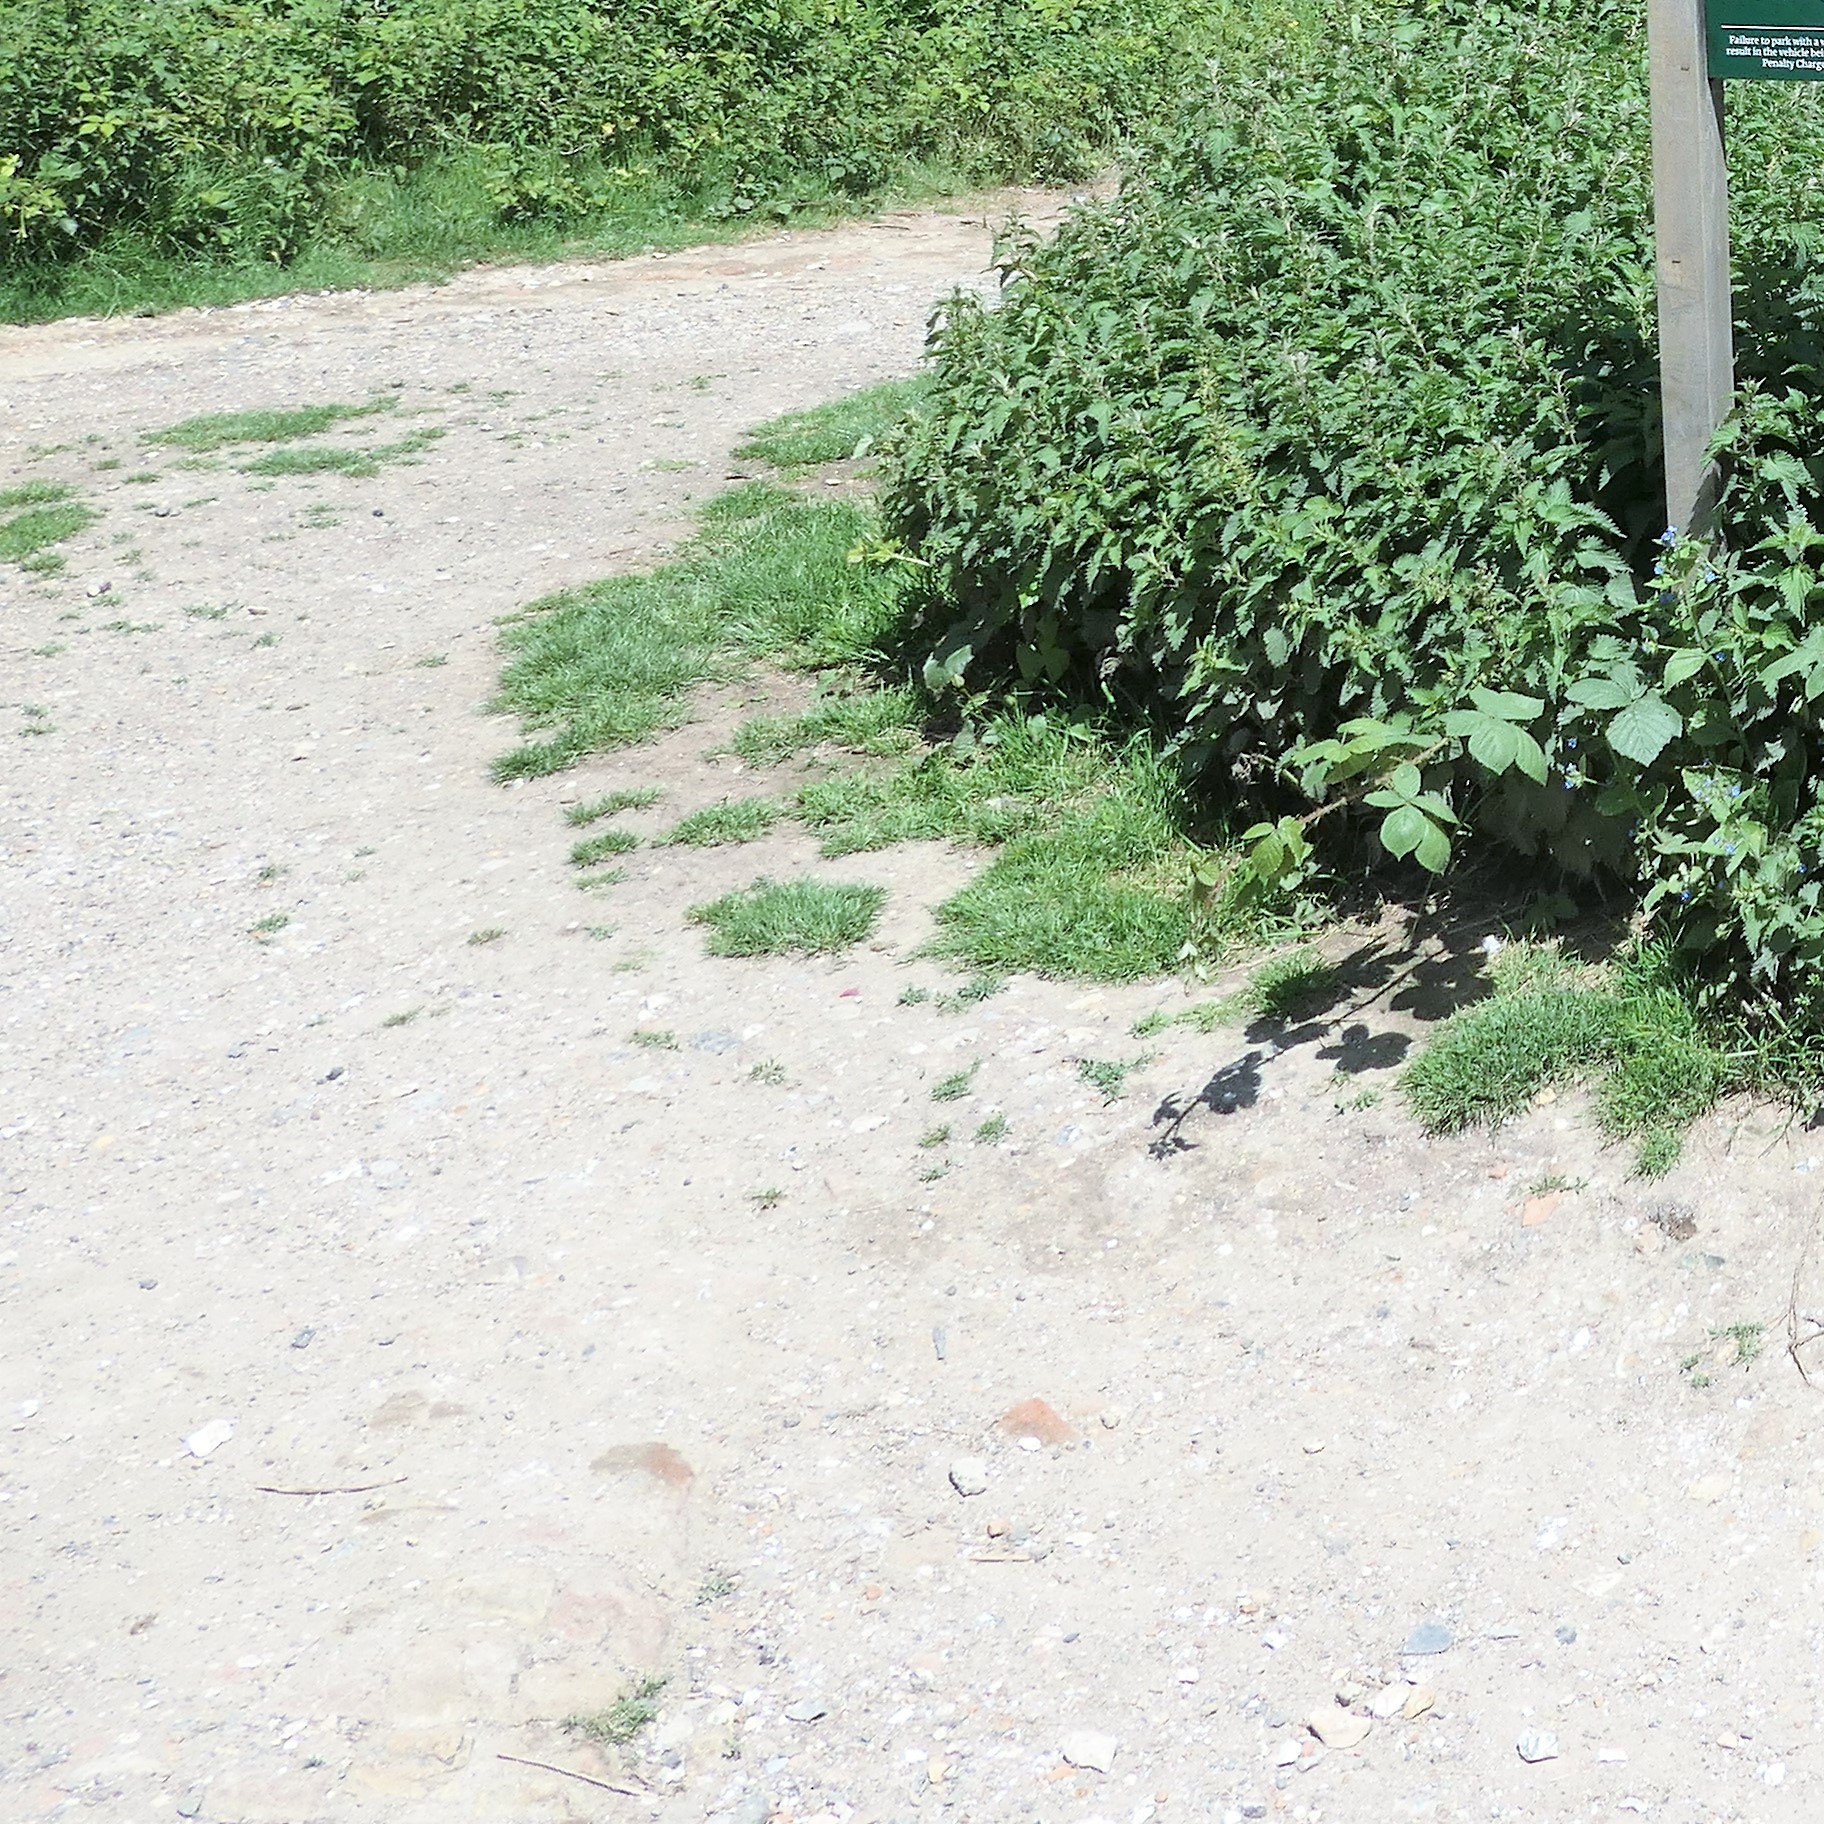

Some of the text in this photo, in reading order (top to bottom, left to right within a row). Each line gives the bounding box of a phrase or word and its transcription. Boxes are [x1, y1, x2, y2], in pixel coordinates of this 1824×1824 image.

[1729, 35, 1759, 45] Failure
[1760, 37, 1770, 45] to
[1771, 36, 1792, 47] park
[1792, 36, 1812, 46] with
[1813, 38, 1819, 46] a
[1726, 46, 1751, 56] result
[1752, 46, 1762, 56] in
[1762, 46, 1778, 57] the
[1779, 47, 1810, 57] vehicle
[1762, 58, 1794, 70] Penalty
